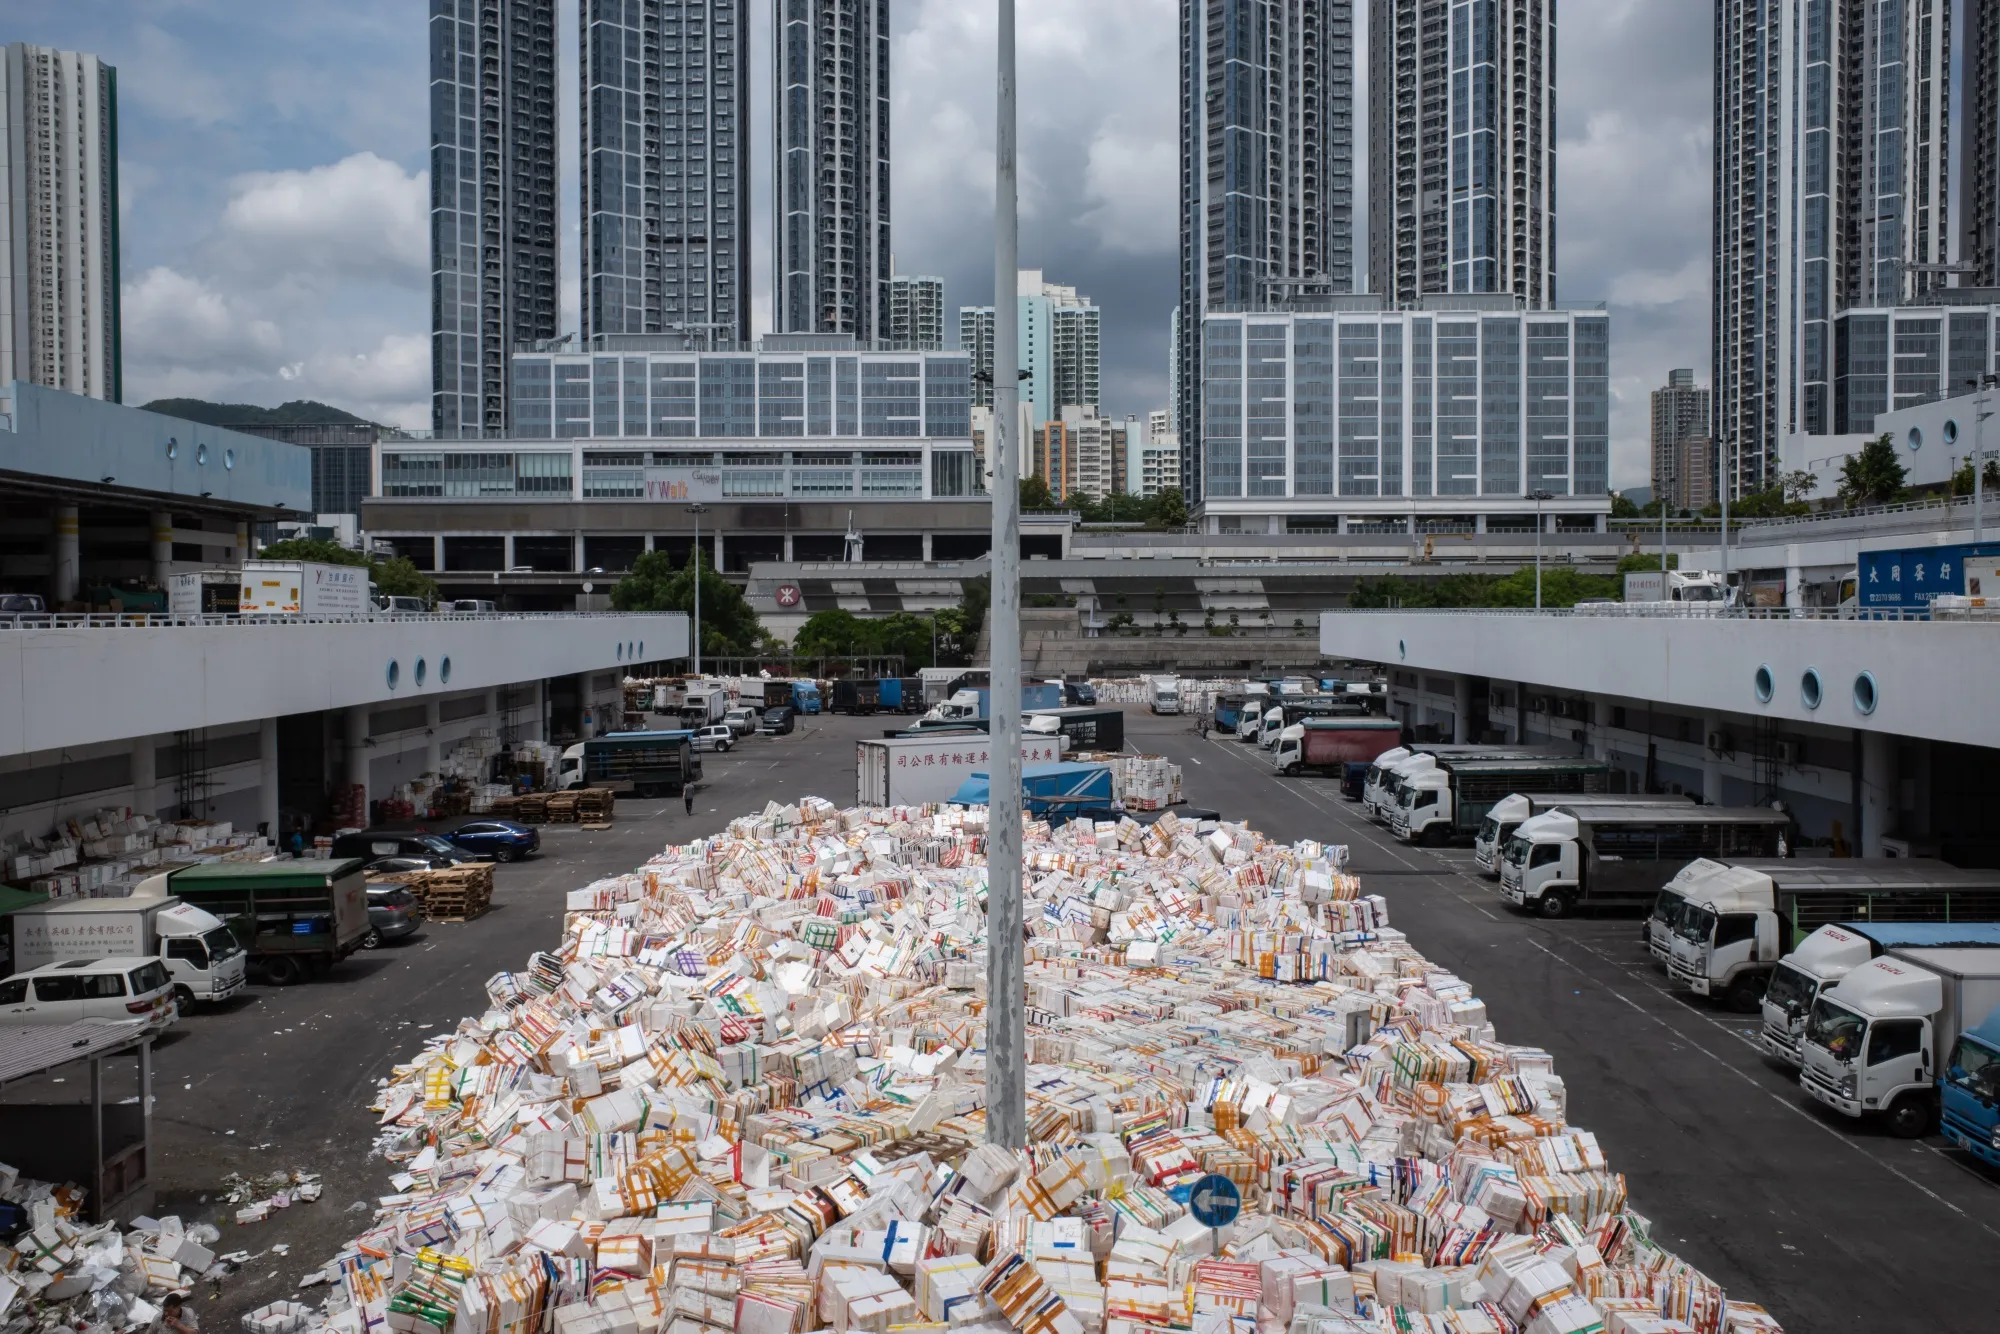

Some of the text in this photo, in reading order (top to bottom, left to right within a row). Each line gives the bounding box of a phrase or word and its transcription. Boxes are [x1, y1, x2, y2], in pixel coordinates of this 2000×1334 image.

[1969, 449, 1999, 461] Ceung
[1823, 929, 1851, 943] ISUZU
[1873, 962, 1906, 976] ISUZU
